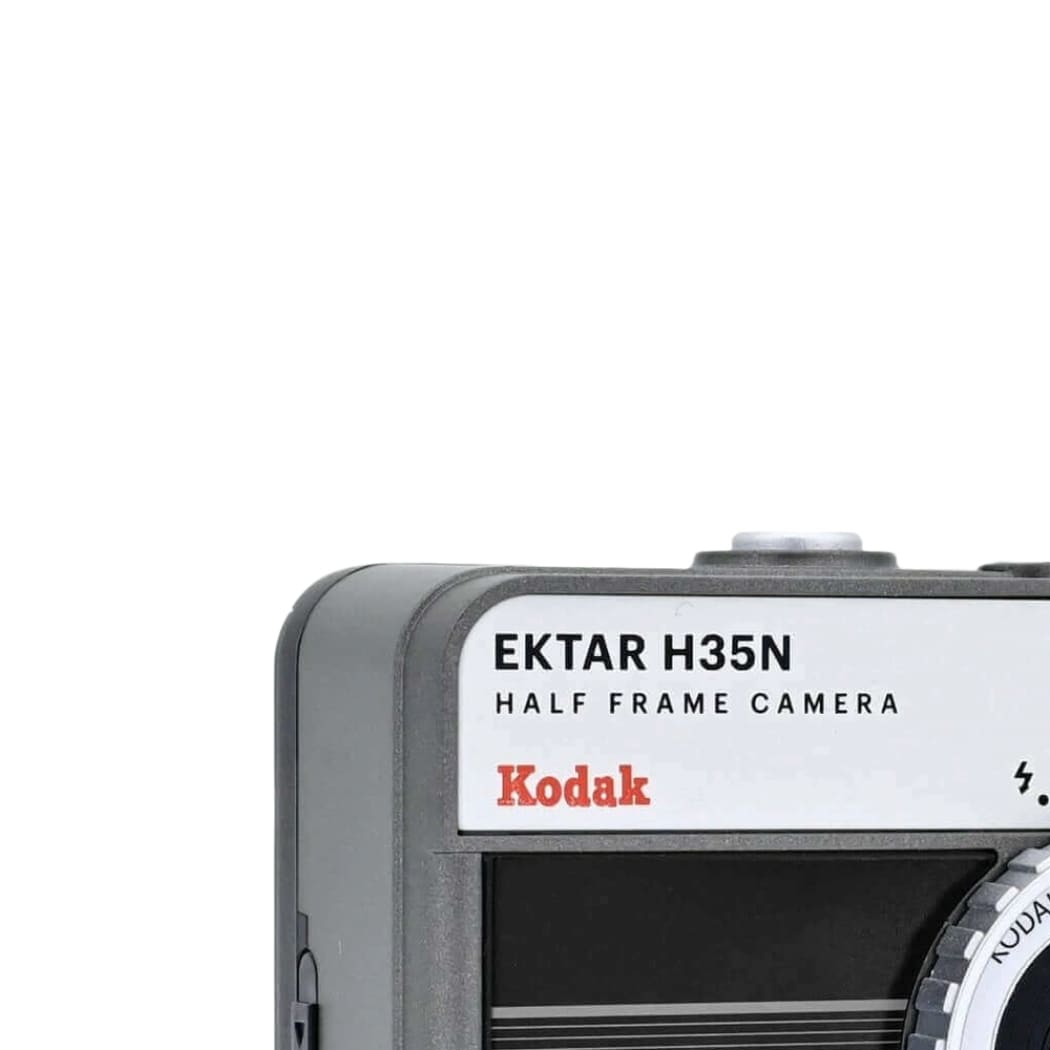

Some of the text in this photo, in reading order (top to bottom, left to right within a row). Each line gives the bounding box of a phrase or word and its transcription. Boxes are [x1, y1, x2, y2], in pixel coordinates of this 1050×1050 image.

[494, 633, 791, 672] EKTAR H35N
[496, 692, 898, 715] HALF FRAME CAMERA
[497, 764, 651, 808] Kodak
